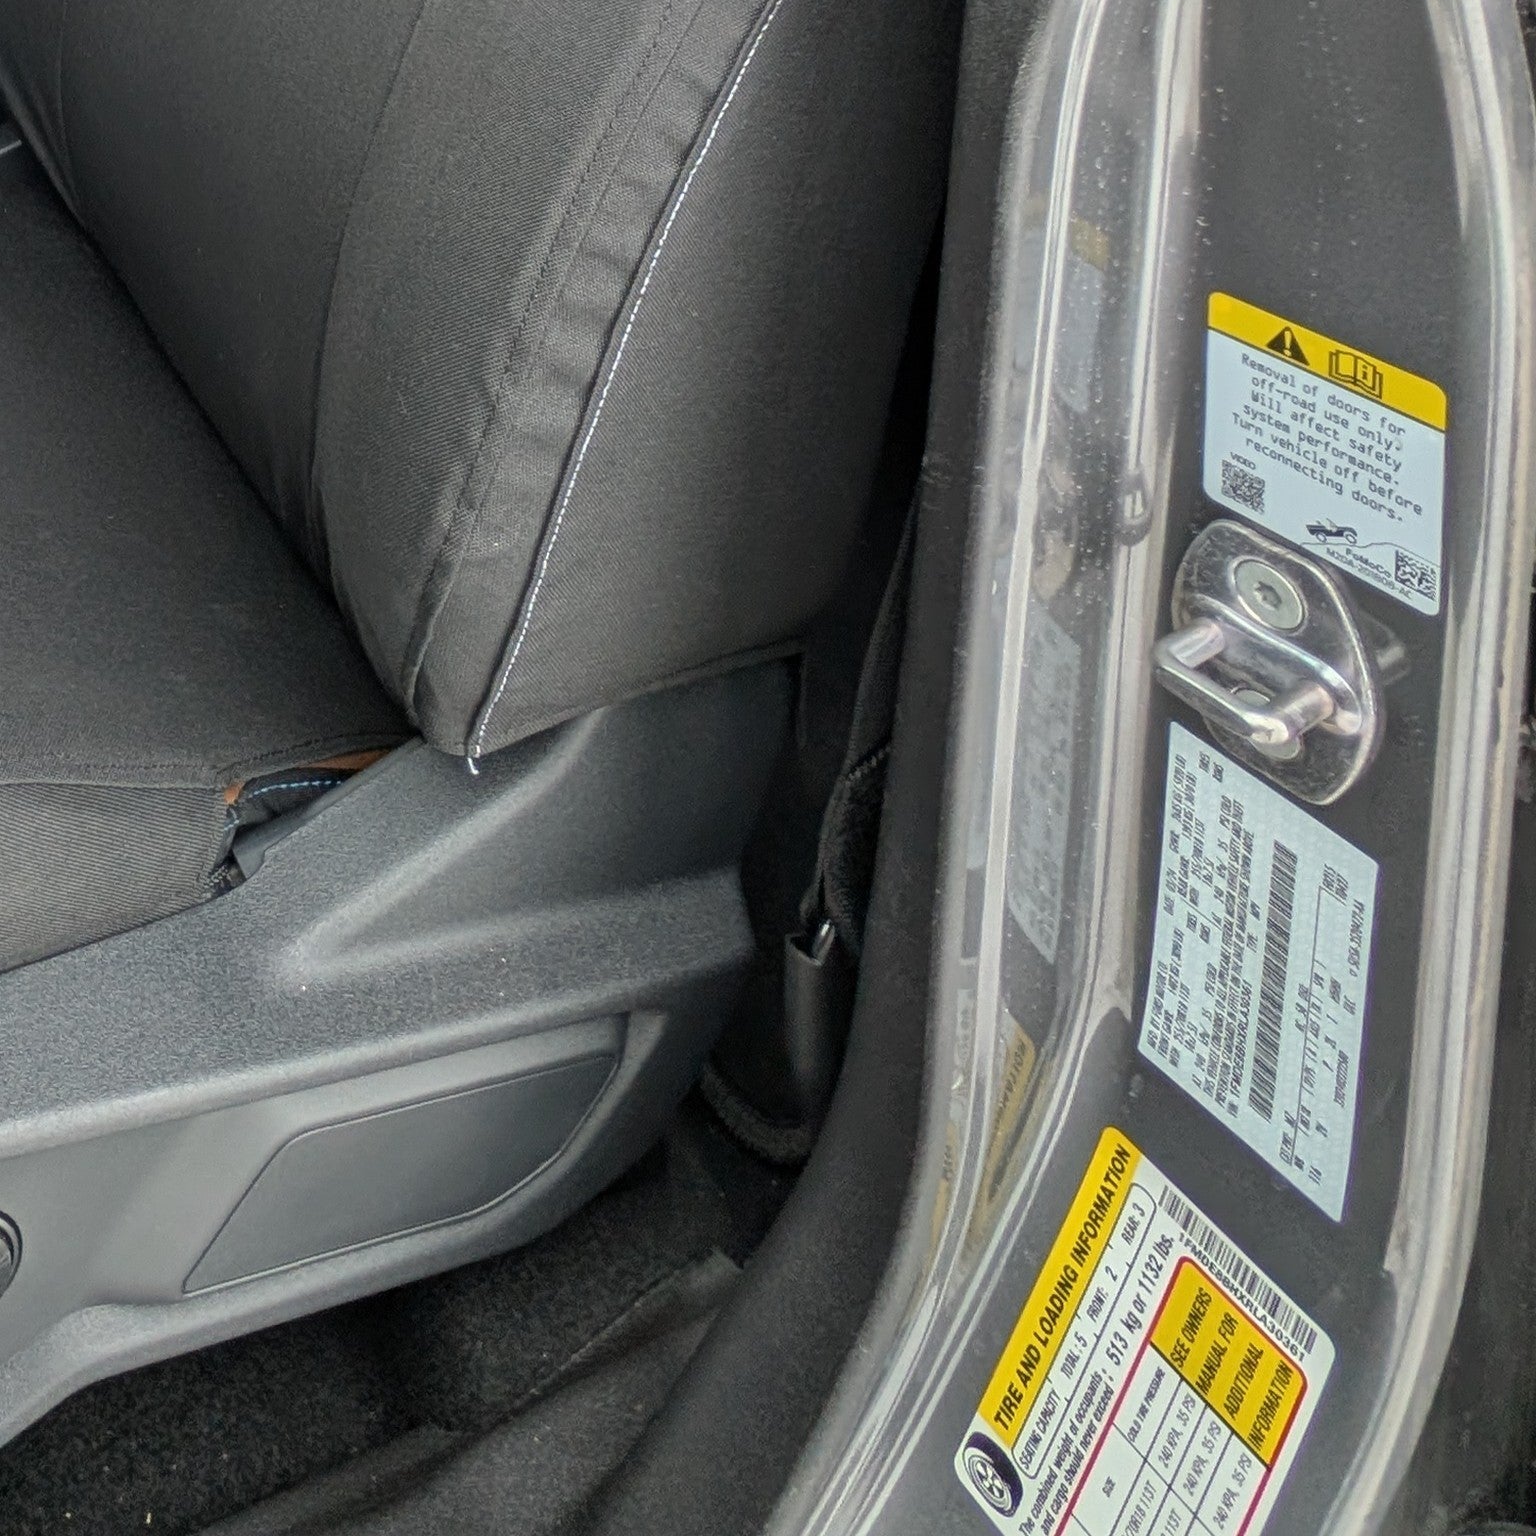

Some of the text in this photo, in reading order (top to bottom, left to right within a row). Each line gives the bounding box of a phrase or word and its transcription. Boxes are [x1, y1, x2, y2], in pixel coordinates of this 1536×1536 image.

[1241, 353, 1406, 436] Removal of doors for
[1251, 377, 1316, 413] off-road
[1324, 410, 1349, 430] use
[1243, 404, 1399, 485] system performance.
[1251, 389, 1402, 472] Will affect safety
[1230, 451, 1256, 471] VIDEO
[1232, 412, 1422, 516] Turn vehicle off before
[1246, 438, 1403, 522] reconnecting doors.
[1345, 547, 1392, 579] FoMoCo
[1121, 1202, 1146, 1246] REAR: 3
[1152, 1234, 1174, 1261] lbs.
[994, 1144, 1130, 1430] TIRE AND LOADING INFORMATION
[1086, 1265, 1118, 1323] FRONT: 2
[1137, 1253, 1164, 1294] 1132
[1120, 1311, 1143, 1334] kg
[1132, 1292, 1147, 1314] or
[1074, 1331, 1088, 1348] 5
[1170, 1287, 1212, 1368] SEE OWNERS
[1105, 1331, 1129, 1366] 513
[1195, 1312, 1239, 1395] MANUAL FOR
[1223, 1344, 1263, 1419] ADDITIONAL
[1127, 1366, 1166, 1443] COLD TIRE PRESSURE
[1175, 1408, 1189, 1427] 35
[1181, 1392, 1196, 1414] PSI
[1248, 1361, 1293, 1450] INFORMATION
[1019, 1388, 1061, 1470] SEATING CAPACITY
[1201, 1435, 1215, 1454] 35
[1207, 1420, 1222, 1441] PSI
[1018, 1371, 1103, 1536] The combined weight of occupants
[1040, 1382, 1114, 1536] and cargo should never exceed
[1158, 1445, 1173, 1469] 240
[1237, 1452, 1252, 1474] PSI
[1102, 1476, 1116, 1498] SIZE
[1182, 1472, 1198, 1496] 240
[1231, 1467, 1245, 1487] 35
[1212, 1506, 1229, 1530] 240
